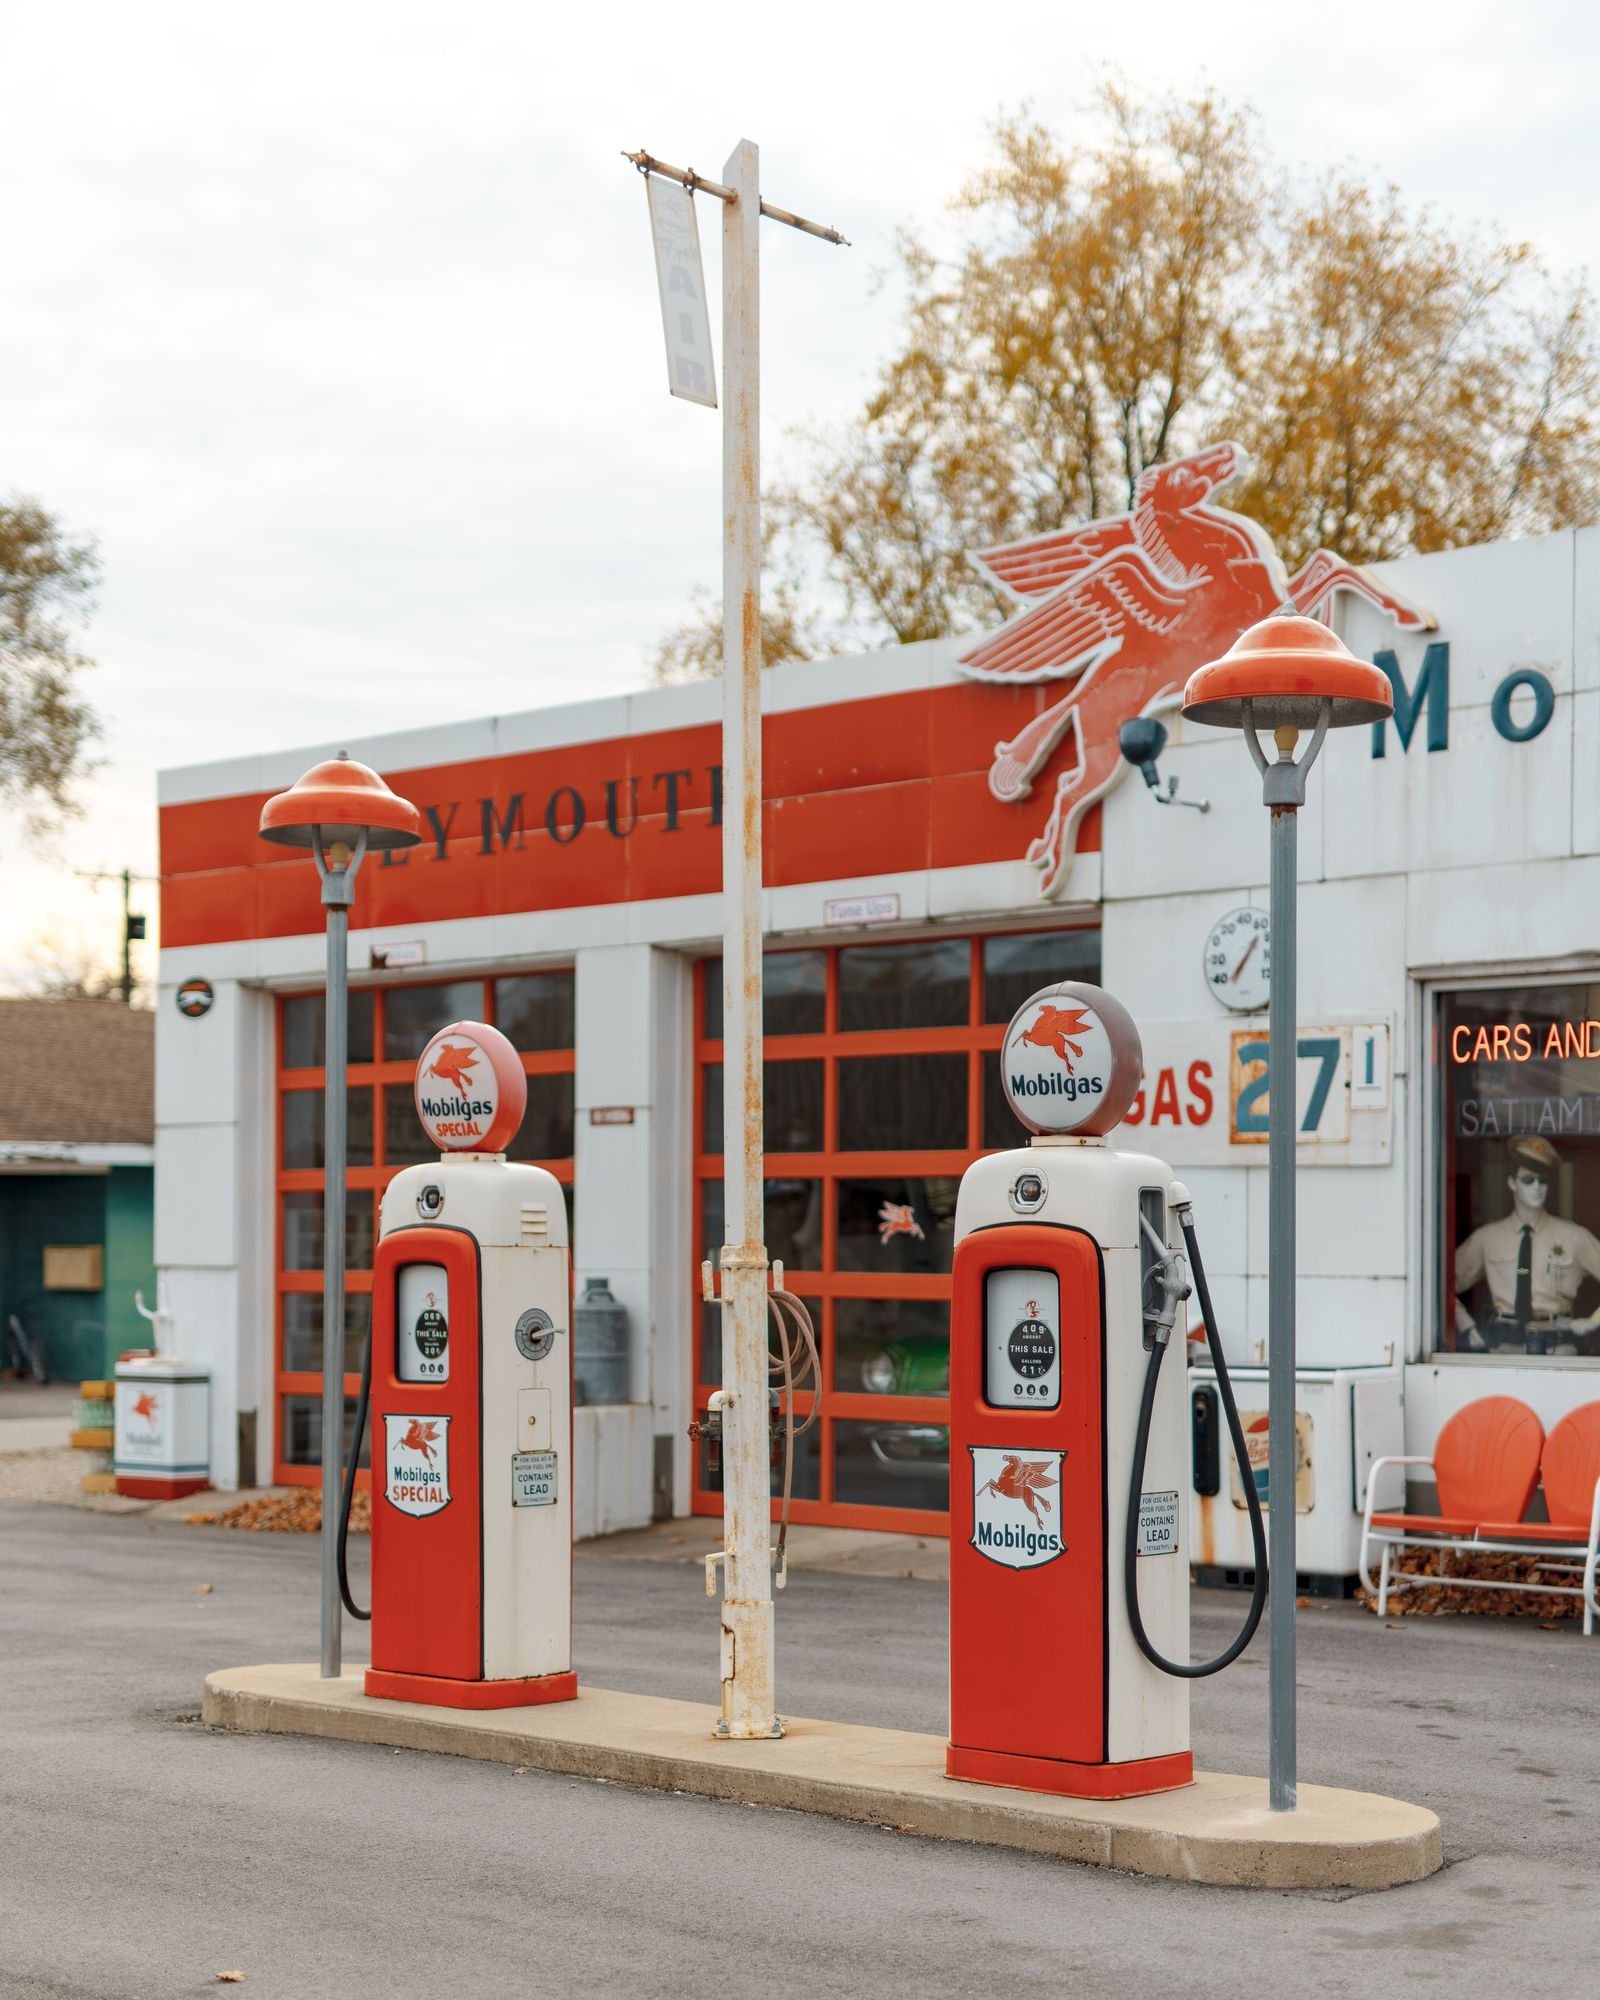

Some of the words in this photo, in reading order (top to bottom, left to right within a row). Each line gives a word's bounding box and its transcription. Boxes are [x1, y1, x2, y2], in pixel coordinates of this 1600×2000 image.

[667, 264, 708, 394] AIR
[379, 766, 723, 867] YMOUT
[1451, 1023, 1533, 1064] CARS
[1543, 1019, 1600, 1060] AND
[1011, 1072, 1103, 1102] Mobilgas
[1236, 1037, 1341, 1133] 27
[421, 1096, 493, 1121] Mobilgas
[436, 1121, 483, 1137] SPECIAL
[416, 1329, 430, 1338] THIS
[431, 1330, 447, 1338] SALE
[1010, 1344, 1029, 1354] THIS
[1032, 1345, 1054, 1354] SALE
[394, 1466, 441, 1486] Mobilgas
[517, 1472, 553, 1482] CONTAINS
[393, 1485, 445, 1503] SPECIAL
[524, 1483, 549, 1495] LEAD
[1153, 1496, 1162, 1504] USE
[1140, 1515, 1175, 1527] CONTAINS
[978, 1522, 1059, 1556] Mobilgas
[1146, 1528, 1170, 1542] LEAD
